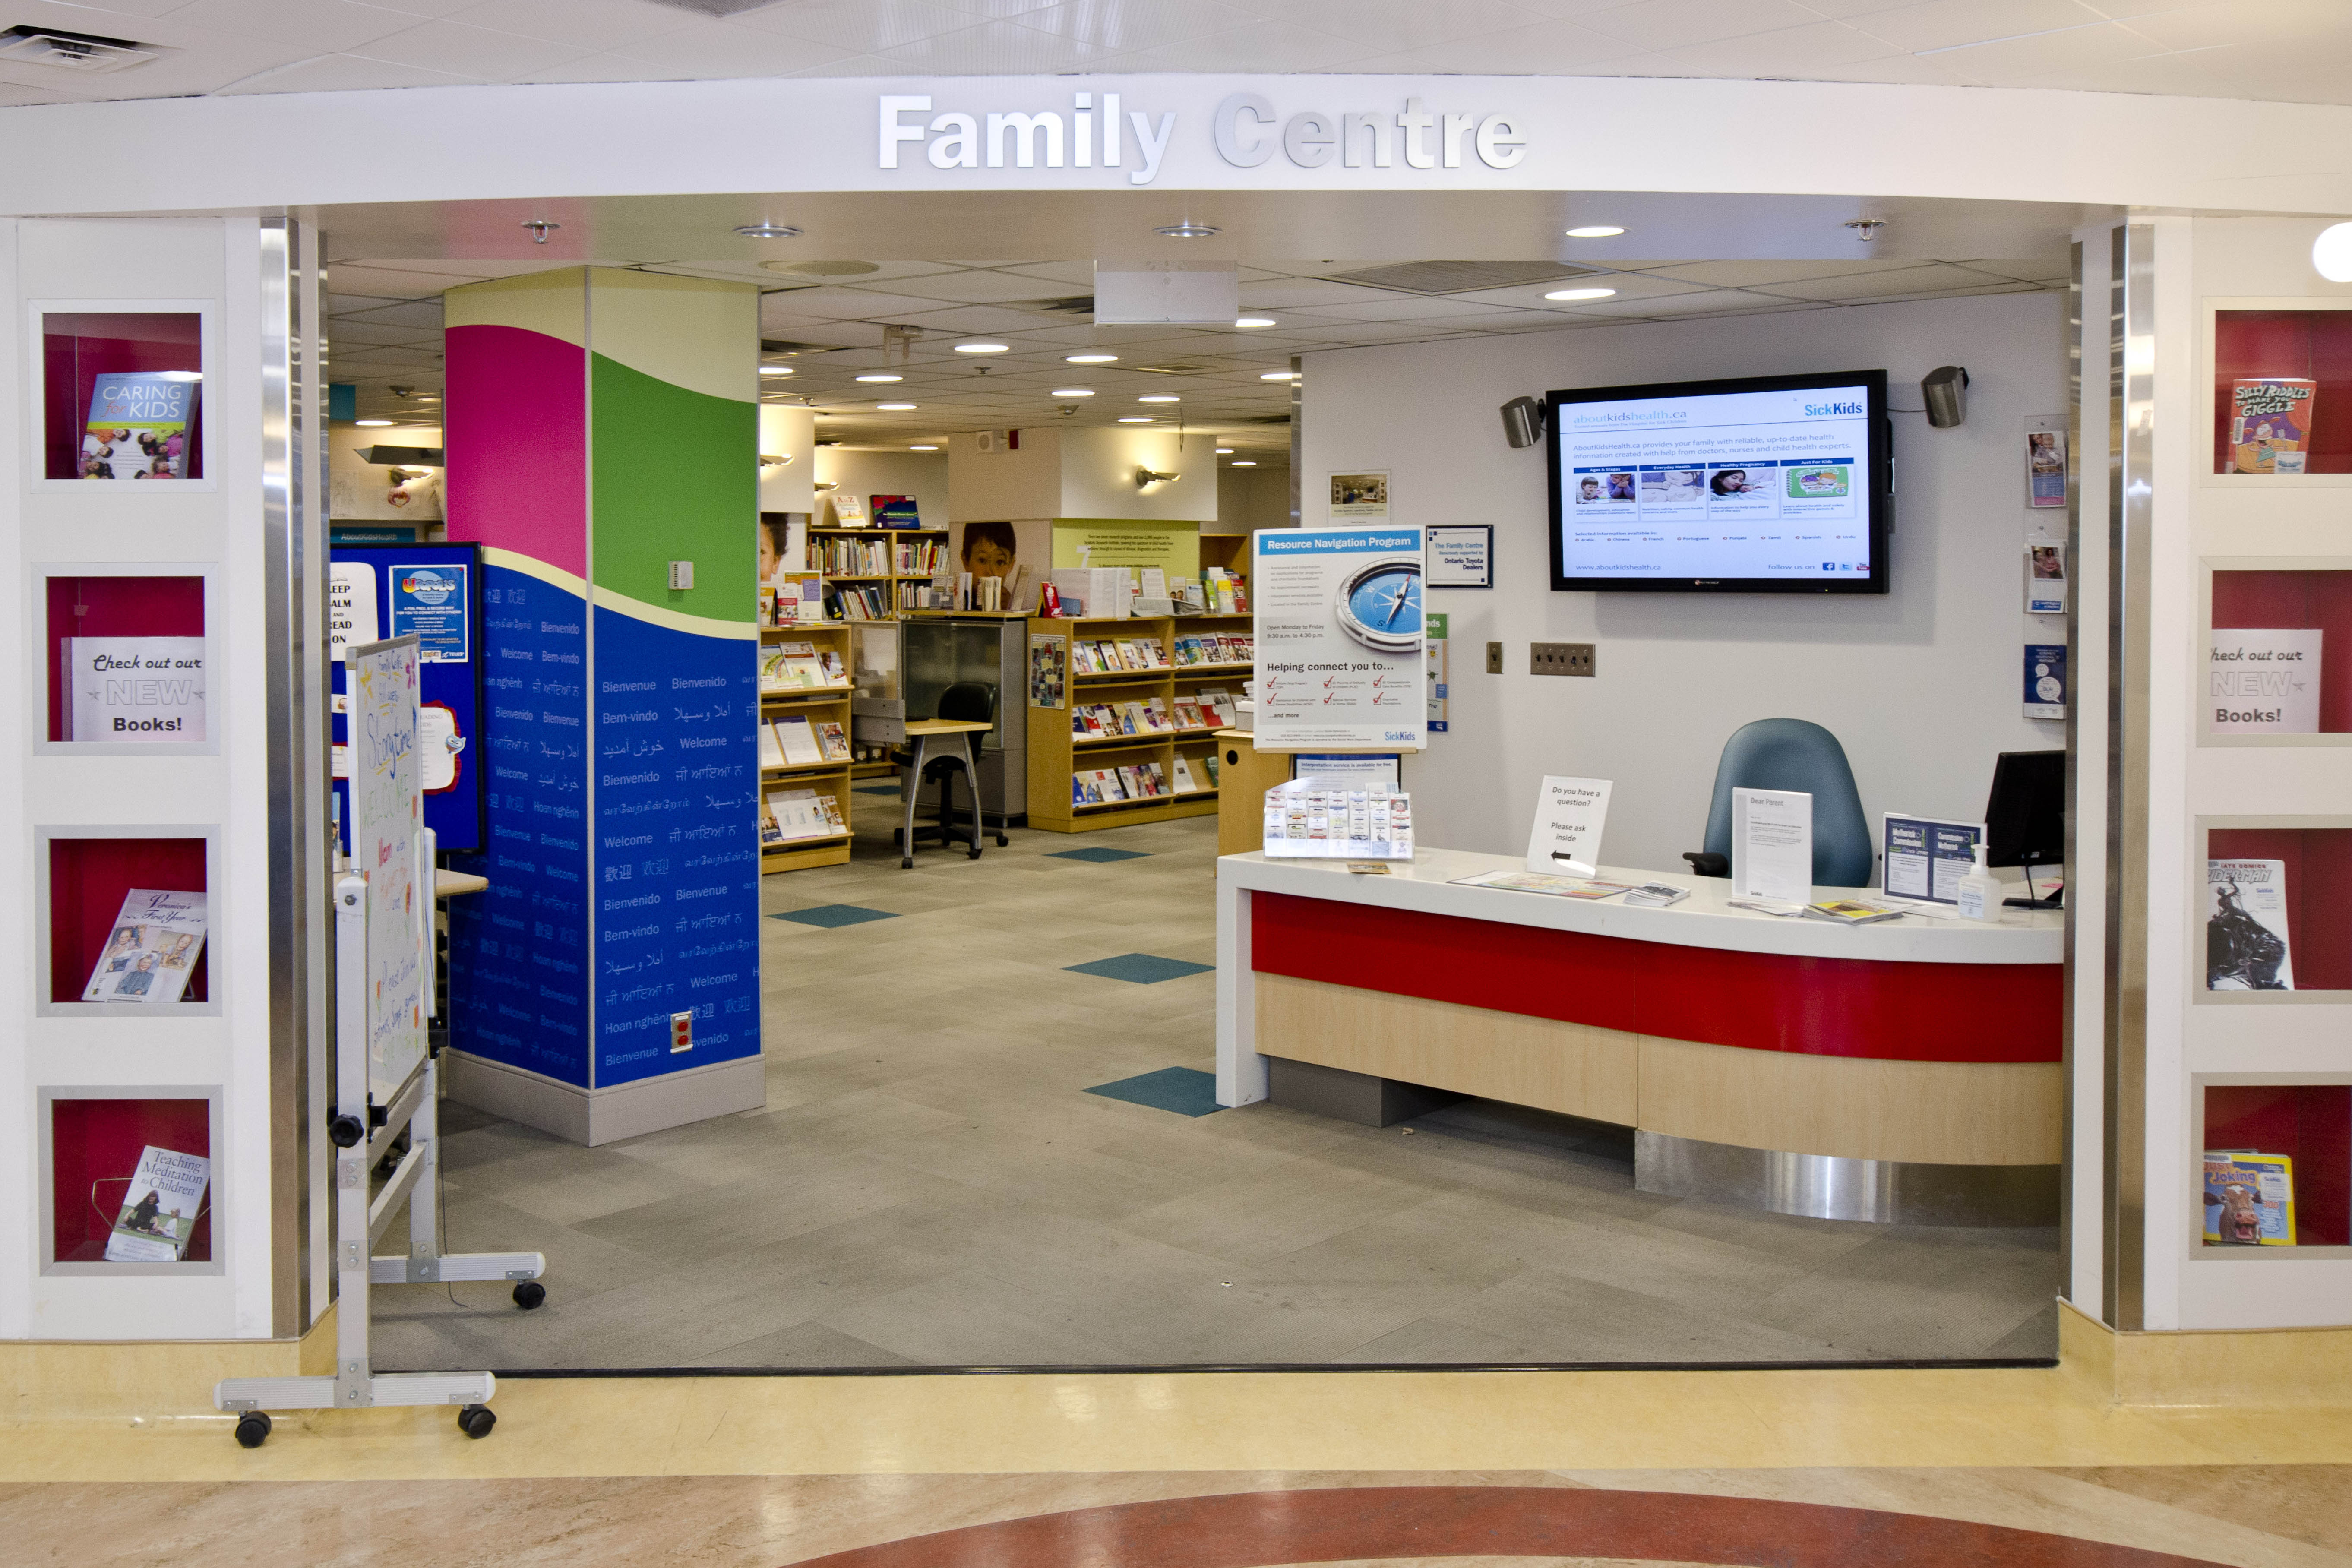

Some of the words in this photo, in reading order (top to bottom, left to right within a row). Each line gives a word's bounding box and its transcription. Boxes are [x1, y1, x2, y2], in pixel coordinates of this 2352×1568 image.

[879, 92, 1177, 185] Family
[1213, 92, 1528, 169] Centre
[102, 384, 181, 401] CARING
[2235, 385, 2267, 400] SILLY
[2266, 385, 2311, 399] RIDDLES
[101, 401, 126, 417] for
[129, 401, 180, 418] KIDS
[1574, 410, 1687, 424] aboutkidshealth.ca
[1805, 402, 1862, 417] SickKids
[2241, 401, 2296, 417] GIGGLE
[1573, 443, 1640, 451] AboutKidsHealth.ca
[1642, 440, 1673, 449] provides
[1767, 435, 1807, 444] up-to-date
[1268, 539, 1312, 550] Resource
[1315, 538, 1366, 550] Navigation
[1369, 537, 1411, 548] Program
[332, 585, 351, 594] EEP
[332, 599, 351, 607] ALM
[332, 621, 352, 629] EAD
[541, 621, 579, 635] Bienvenido
[332, 635, 346, 643] ON
[500, 648, 533, 660] Welcome
[2211, 647, 2245, 661] heck
[2248, 650, 2273, 661] out
[2277, 652, 2304, 661] our
[93, 654, 141, 671] Check
[145, 658, 170, 669] out
[175, 658, 202, 669] our
[1267, 663, 1305, 673] Helping
[1308, 663, 1347, 671] connect
[1352, 664, 1369, 673] you
[1372, 662, 1394, 671] to...
[603, 681, 657, 693] Bienvenue
[672, 676, 727, 689] Bienvenido
[2211, 671, 2293, 696] NEW
[107, 680, 193, 705] NEW
[603, 710, 658, 724] Bem-vindo
[2216, 708, 2282, 723] Books!
[113, 717, 182, 732] Books!
[680, 737, 727, 749] Welcome
[1385, 732, 1416, 741] SickKids
[603, 771, 660, 786] Bienvenido
[1577, 788, 1595, 797] have
[1557, 798, 1591, 808] question?
[1765, 798, 1784, 806] Parent
[1551, 822, 1572, 831] Please
[1574, 823, 1586, 832] ask
[604, 834, 653, 849] Welcome
[1556, 833, 1576, 842] inside
[604, 893, 661, 911] Bienvenido
[676, 885, 728, 901] Bienvenue
[604, 924, 660, 943] Bem-vindo
[691, 973, 737, 989] Welcome
[605, 1021, 632, 1034] Hoan
[605, 1047, 658, 1066] Bienvenue
[154, 1151, 202, 1174] Teaching
[142, 1161, 203, 1185] Meditation
[2213, 1170, 2256, 1184] Joking
[149, 1176, 195, 1196] Children
